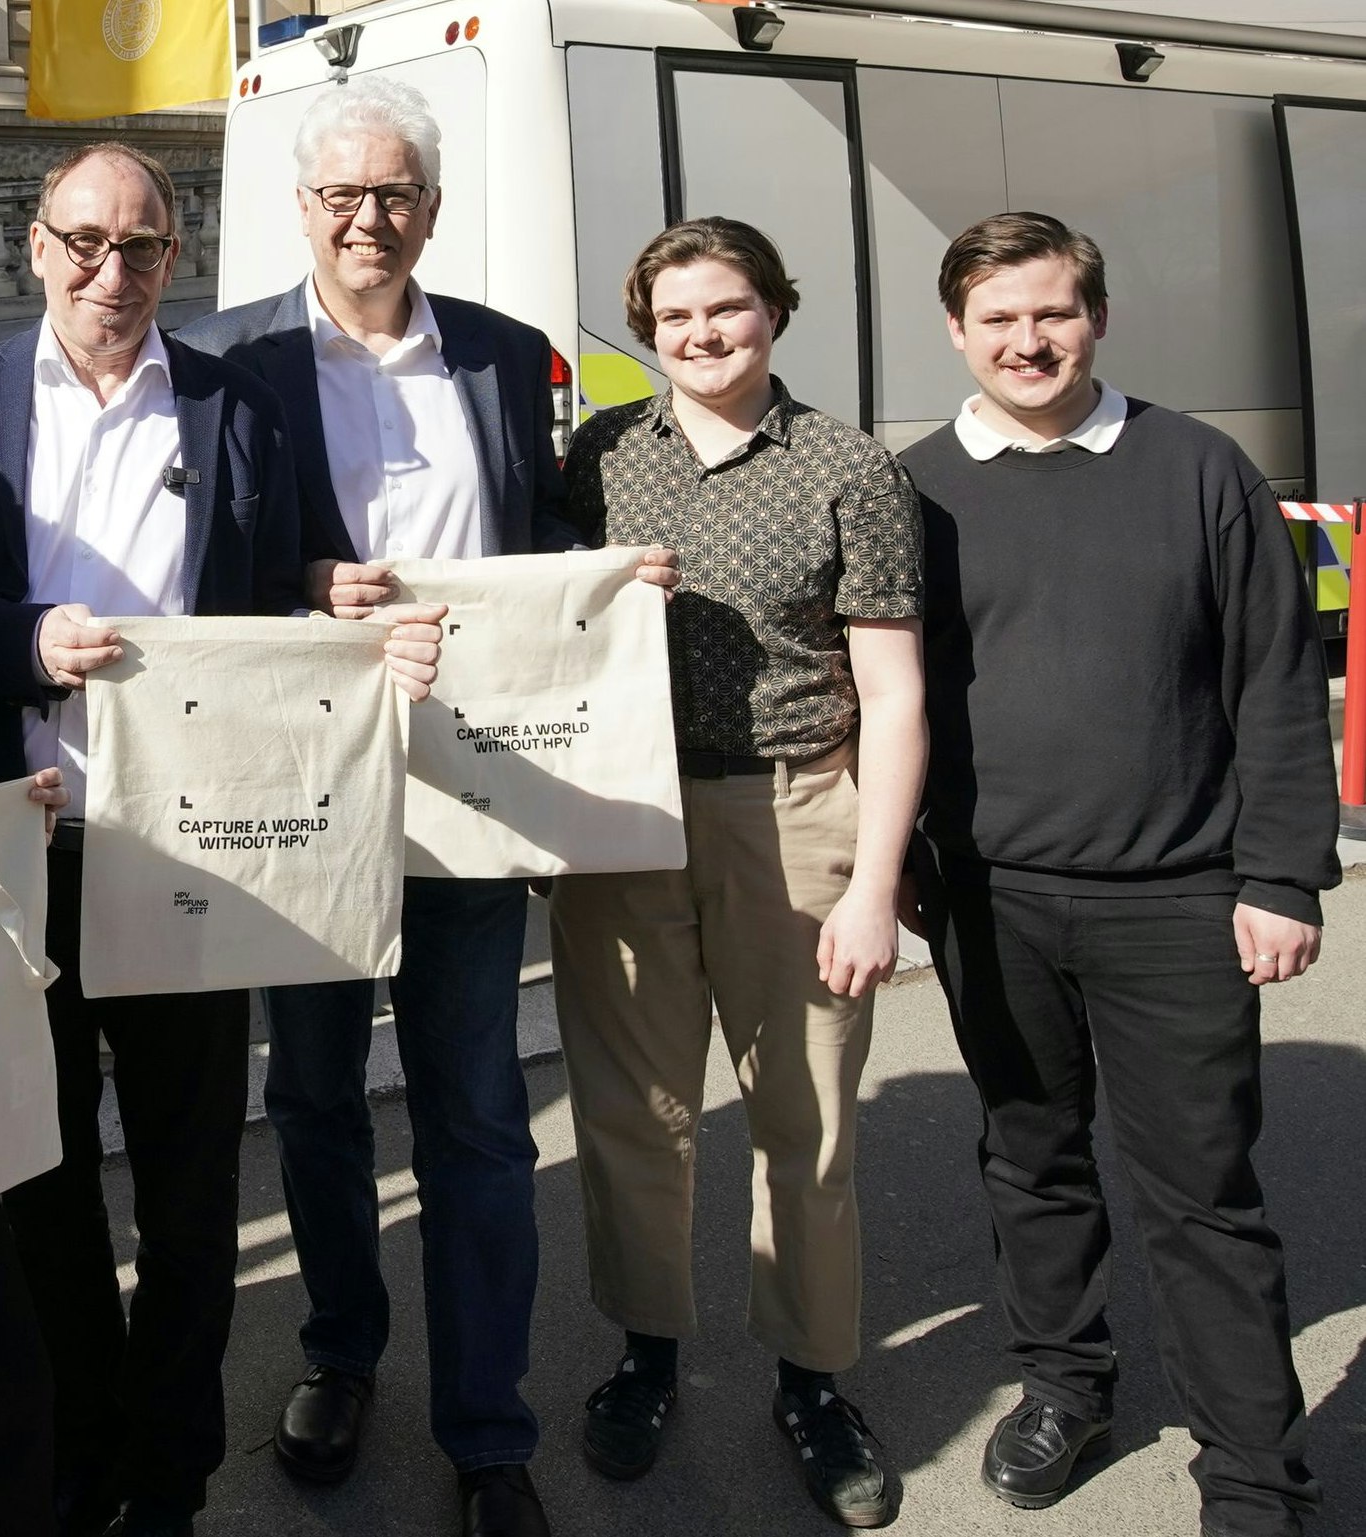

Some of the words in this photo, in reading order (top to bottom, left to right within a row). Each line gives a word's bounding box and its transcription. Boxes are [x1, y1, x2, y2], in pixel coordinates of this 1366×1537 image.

[456, 725, 519, 741] CAPTURE
[523, 725, 532, 736] A
[536, 722, 590, 735] WORLD
[474, 738, 540, 754] WITHOUT
[543, 737, 573, 749] HPV
[460, 791, 475, 799] HPV
[178, 820, 254, 834] CAPTURE
[257, 820, 268, 833] A
[272, 818, 329, 832] WORLD
[198, 836, 275, 850] WITHOUT
[278, 834, 310, 848] HPV
[174, 891, 191, 899] HPV
[174, 899, 209, 907] IMPFUNG
